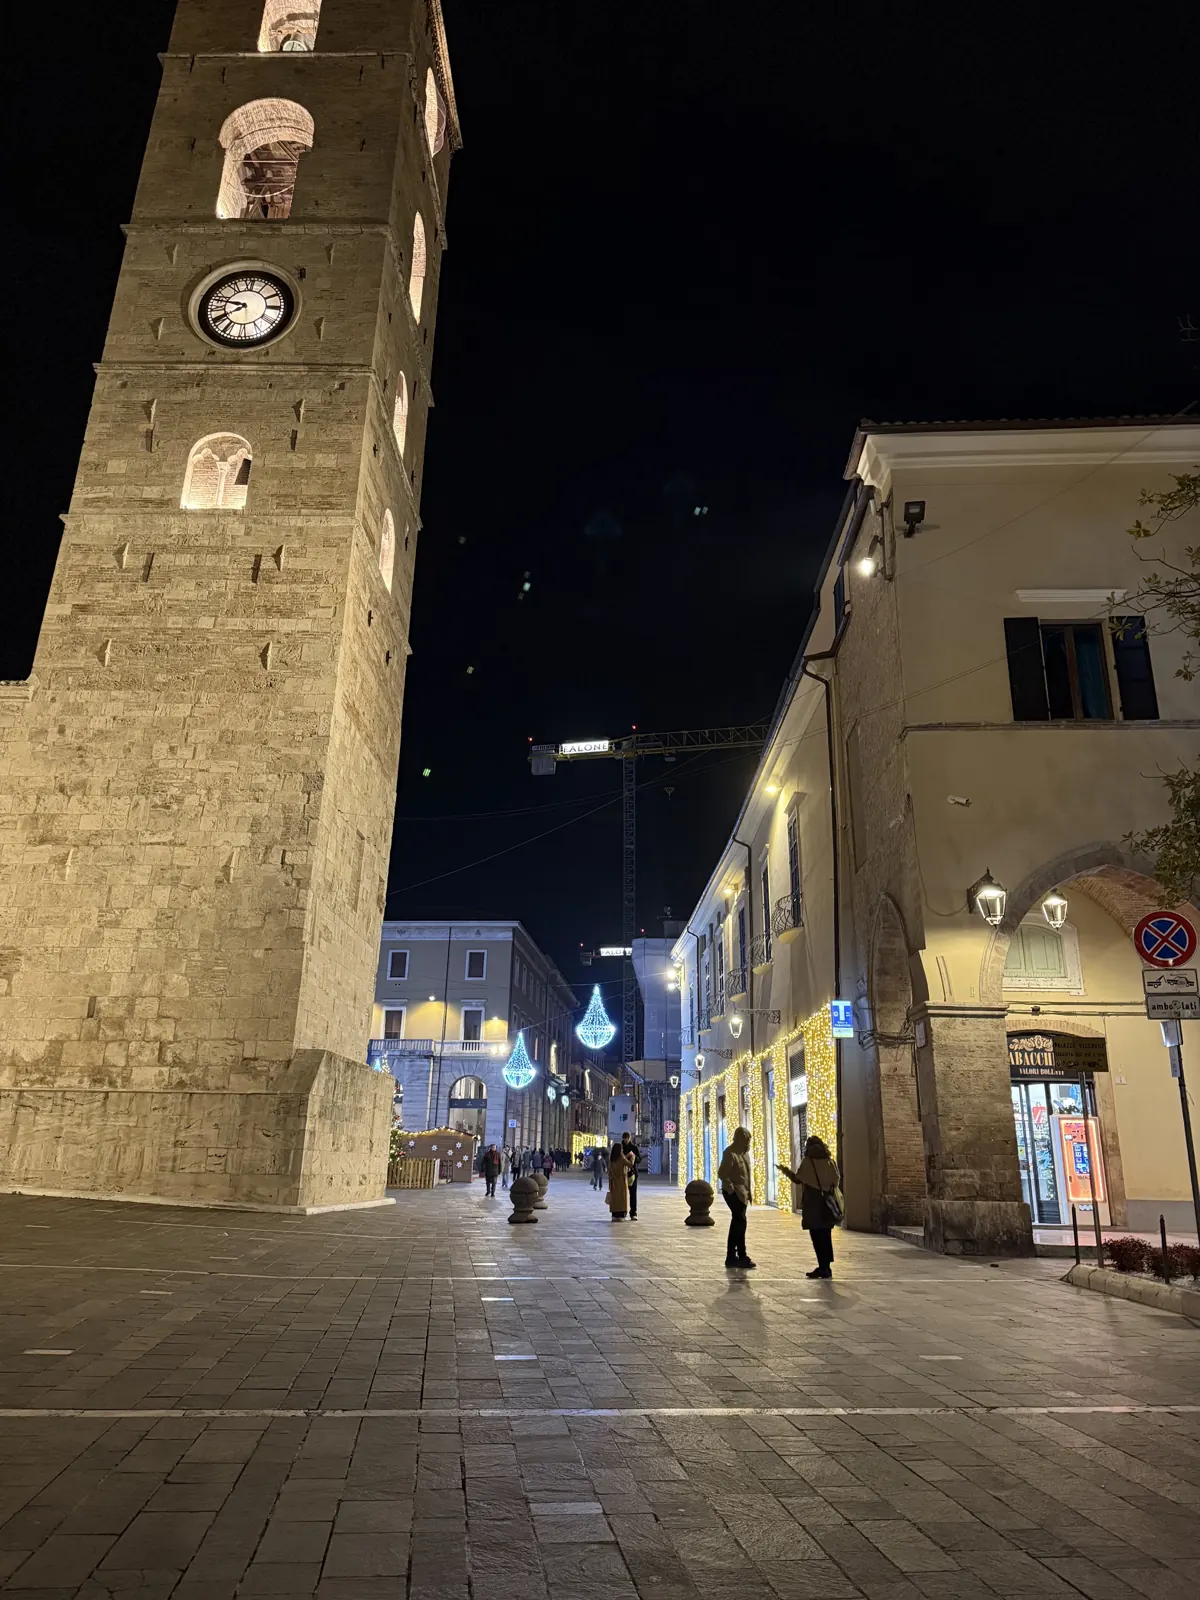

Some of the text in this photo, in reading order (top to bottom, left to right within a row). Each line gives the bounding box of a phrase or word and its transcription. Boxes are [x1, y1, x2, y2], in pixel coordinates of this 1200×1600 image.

[1152, 1002, 1174, 1010] ambo
[1181, 1001, 1197, 1010] lati
[1019, 1067, 1040, 1075] VALORI
